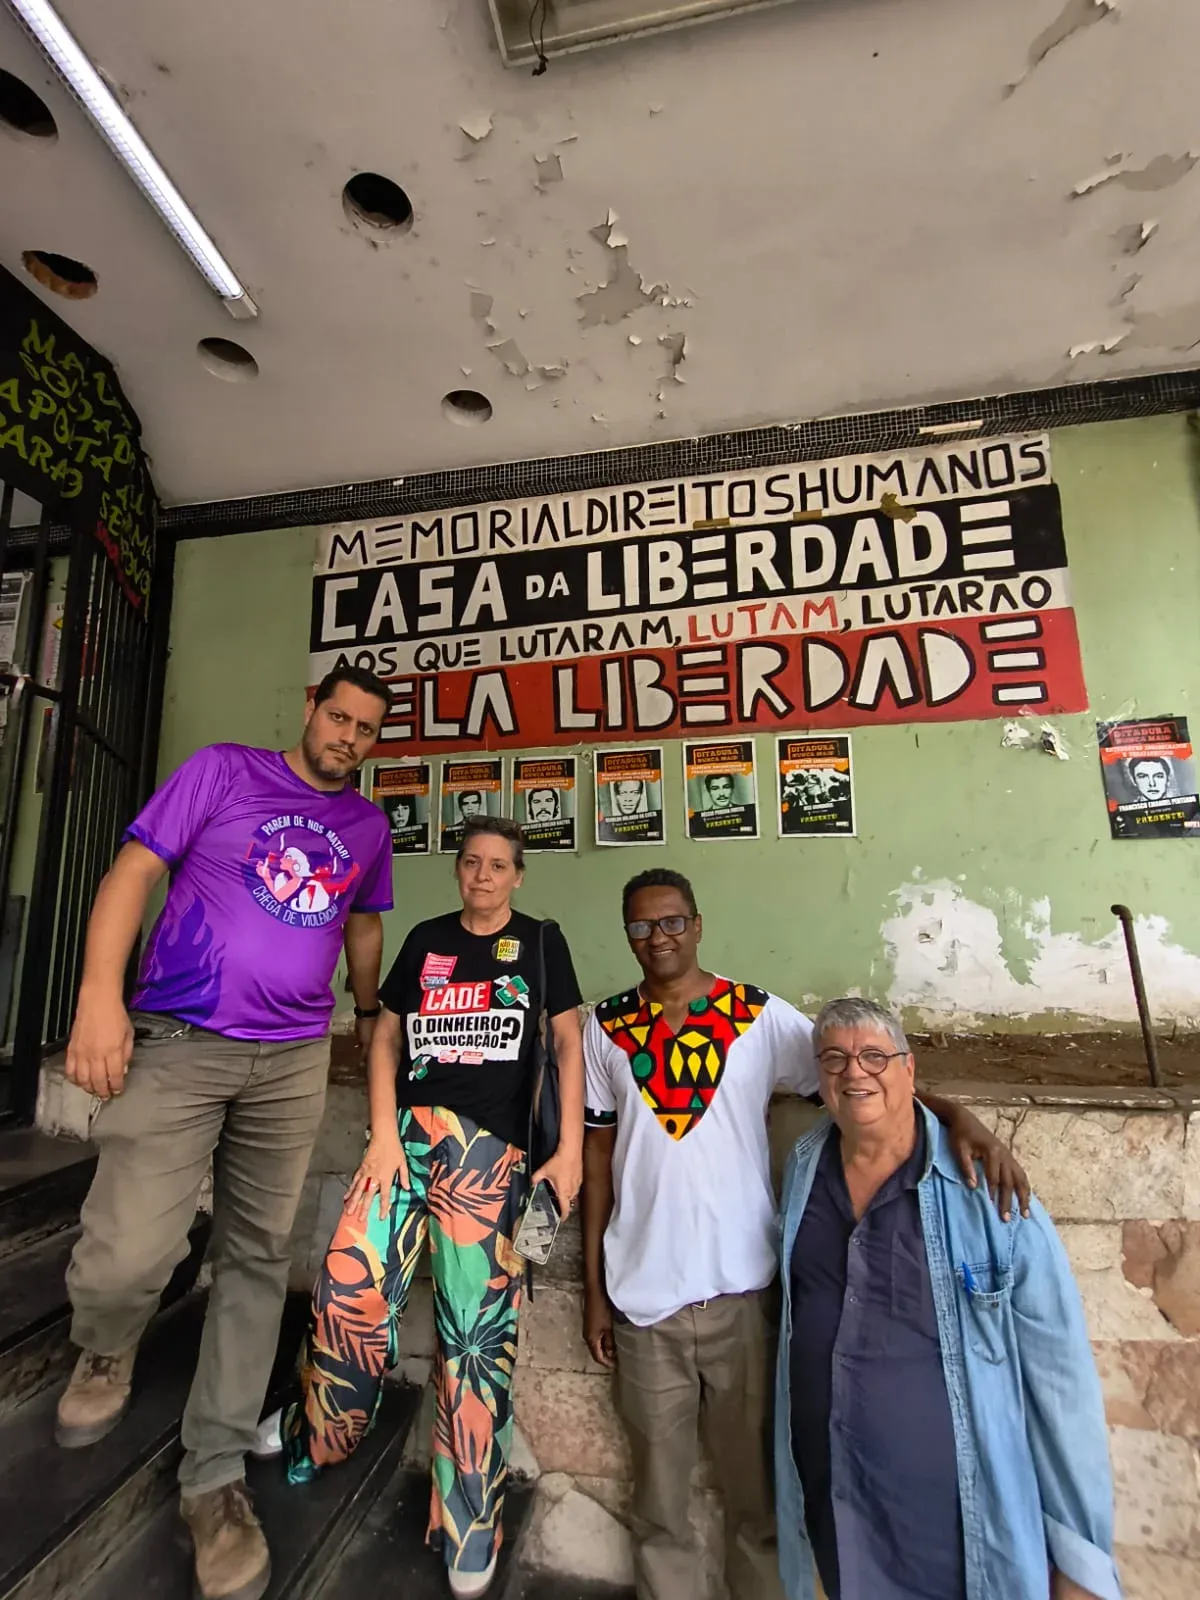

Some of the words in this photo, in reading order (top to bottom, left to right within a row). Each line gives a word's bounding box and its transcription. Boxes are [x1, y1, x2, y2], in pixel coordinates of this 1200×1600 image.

[320, 560, 508, 643] CASA
[525, 572, 570, 601] DA
[587, 500, 1015, 612] LIBERDADE
[331, 647, 397, 675] AOS
[413, 638, 481, 672] QUE
[500, 616, 682, 661] LUTARAM,
[687, 596, 852, 643] LUTAM,
[377, 668, 520, 743] ELA
[553, 615, 1049, 734] LIBERDADE
[261, 815, 291, 836] PAREM
[294, 816, 304, 827] DE
[307, 819, 324, 834] NOS
[1136, 811, 1185, 824] PRESENTE!
[252, 885, 281, 917] CHEGA
[283, 910, 297, 925] DE
[425, 983, 486, 1011] CADÊ
[413, 1018, 422, 1034] O
[426, 1016, 501, 1033] DINHEIRO
[414, 1036, 431, 1050] DA
[434, 1032, 499, 1049] EDUCAÇÃO
